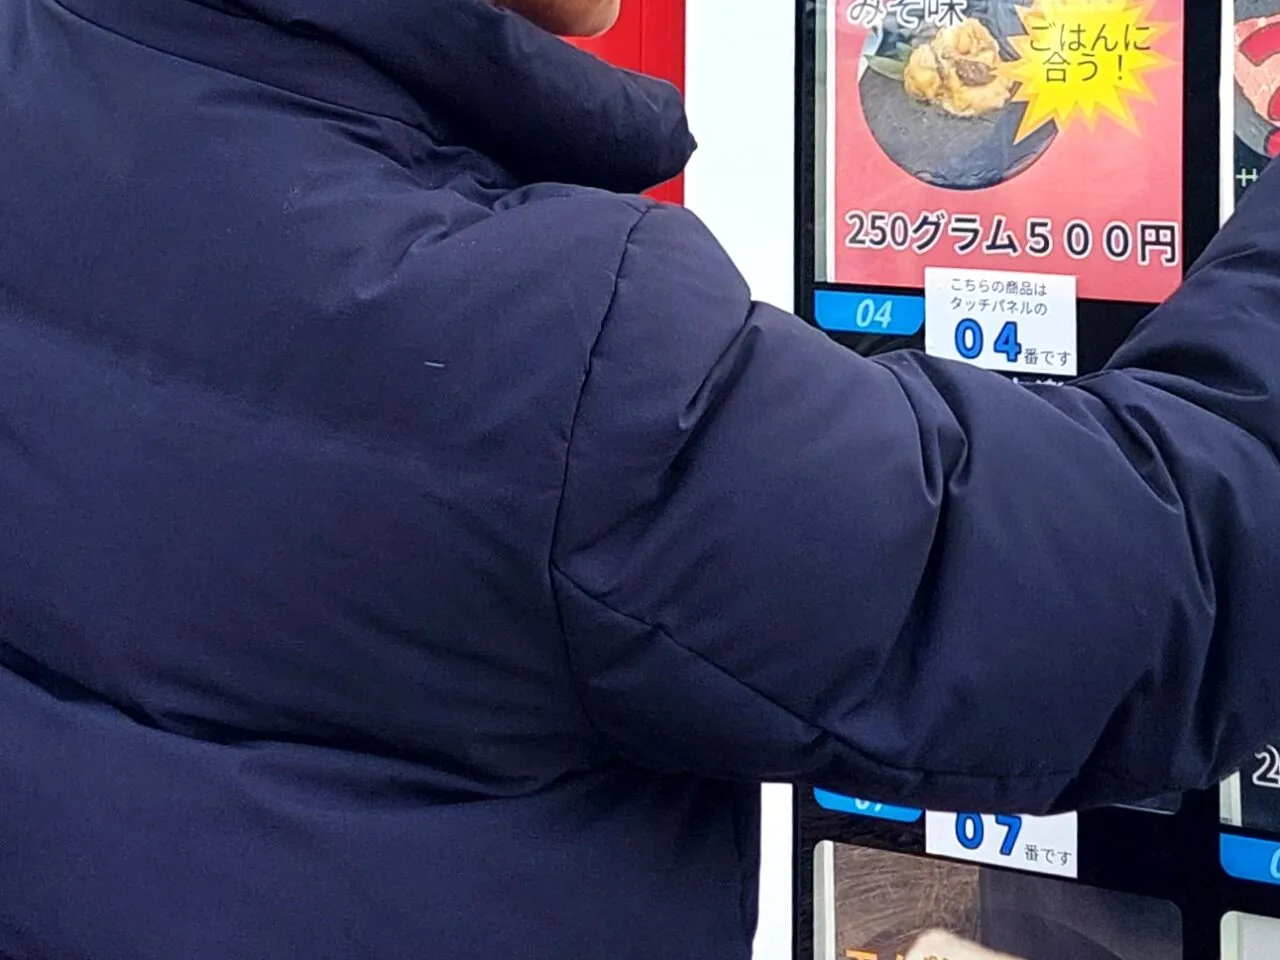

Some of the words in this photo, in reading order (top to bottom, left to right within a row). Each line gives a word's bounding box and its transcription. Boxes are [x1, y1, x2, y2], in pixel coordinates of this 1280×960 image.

[1030, 23, 1151, 52] ごはんに
[1045, 54, 1127, 84] 合う！
[951, 278, 1047, 297] こちらの商品は
[857, 299, 892, 328] 04
[951, 297, 1047, 316] タッチパネルの
